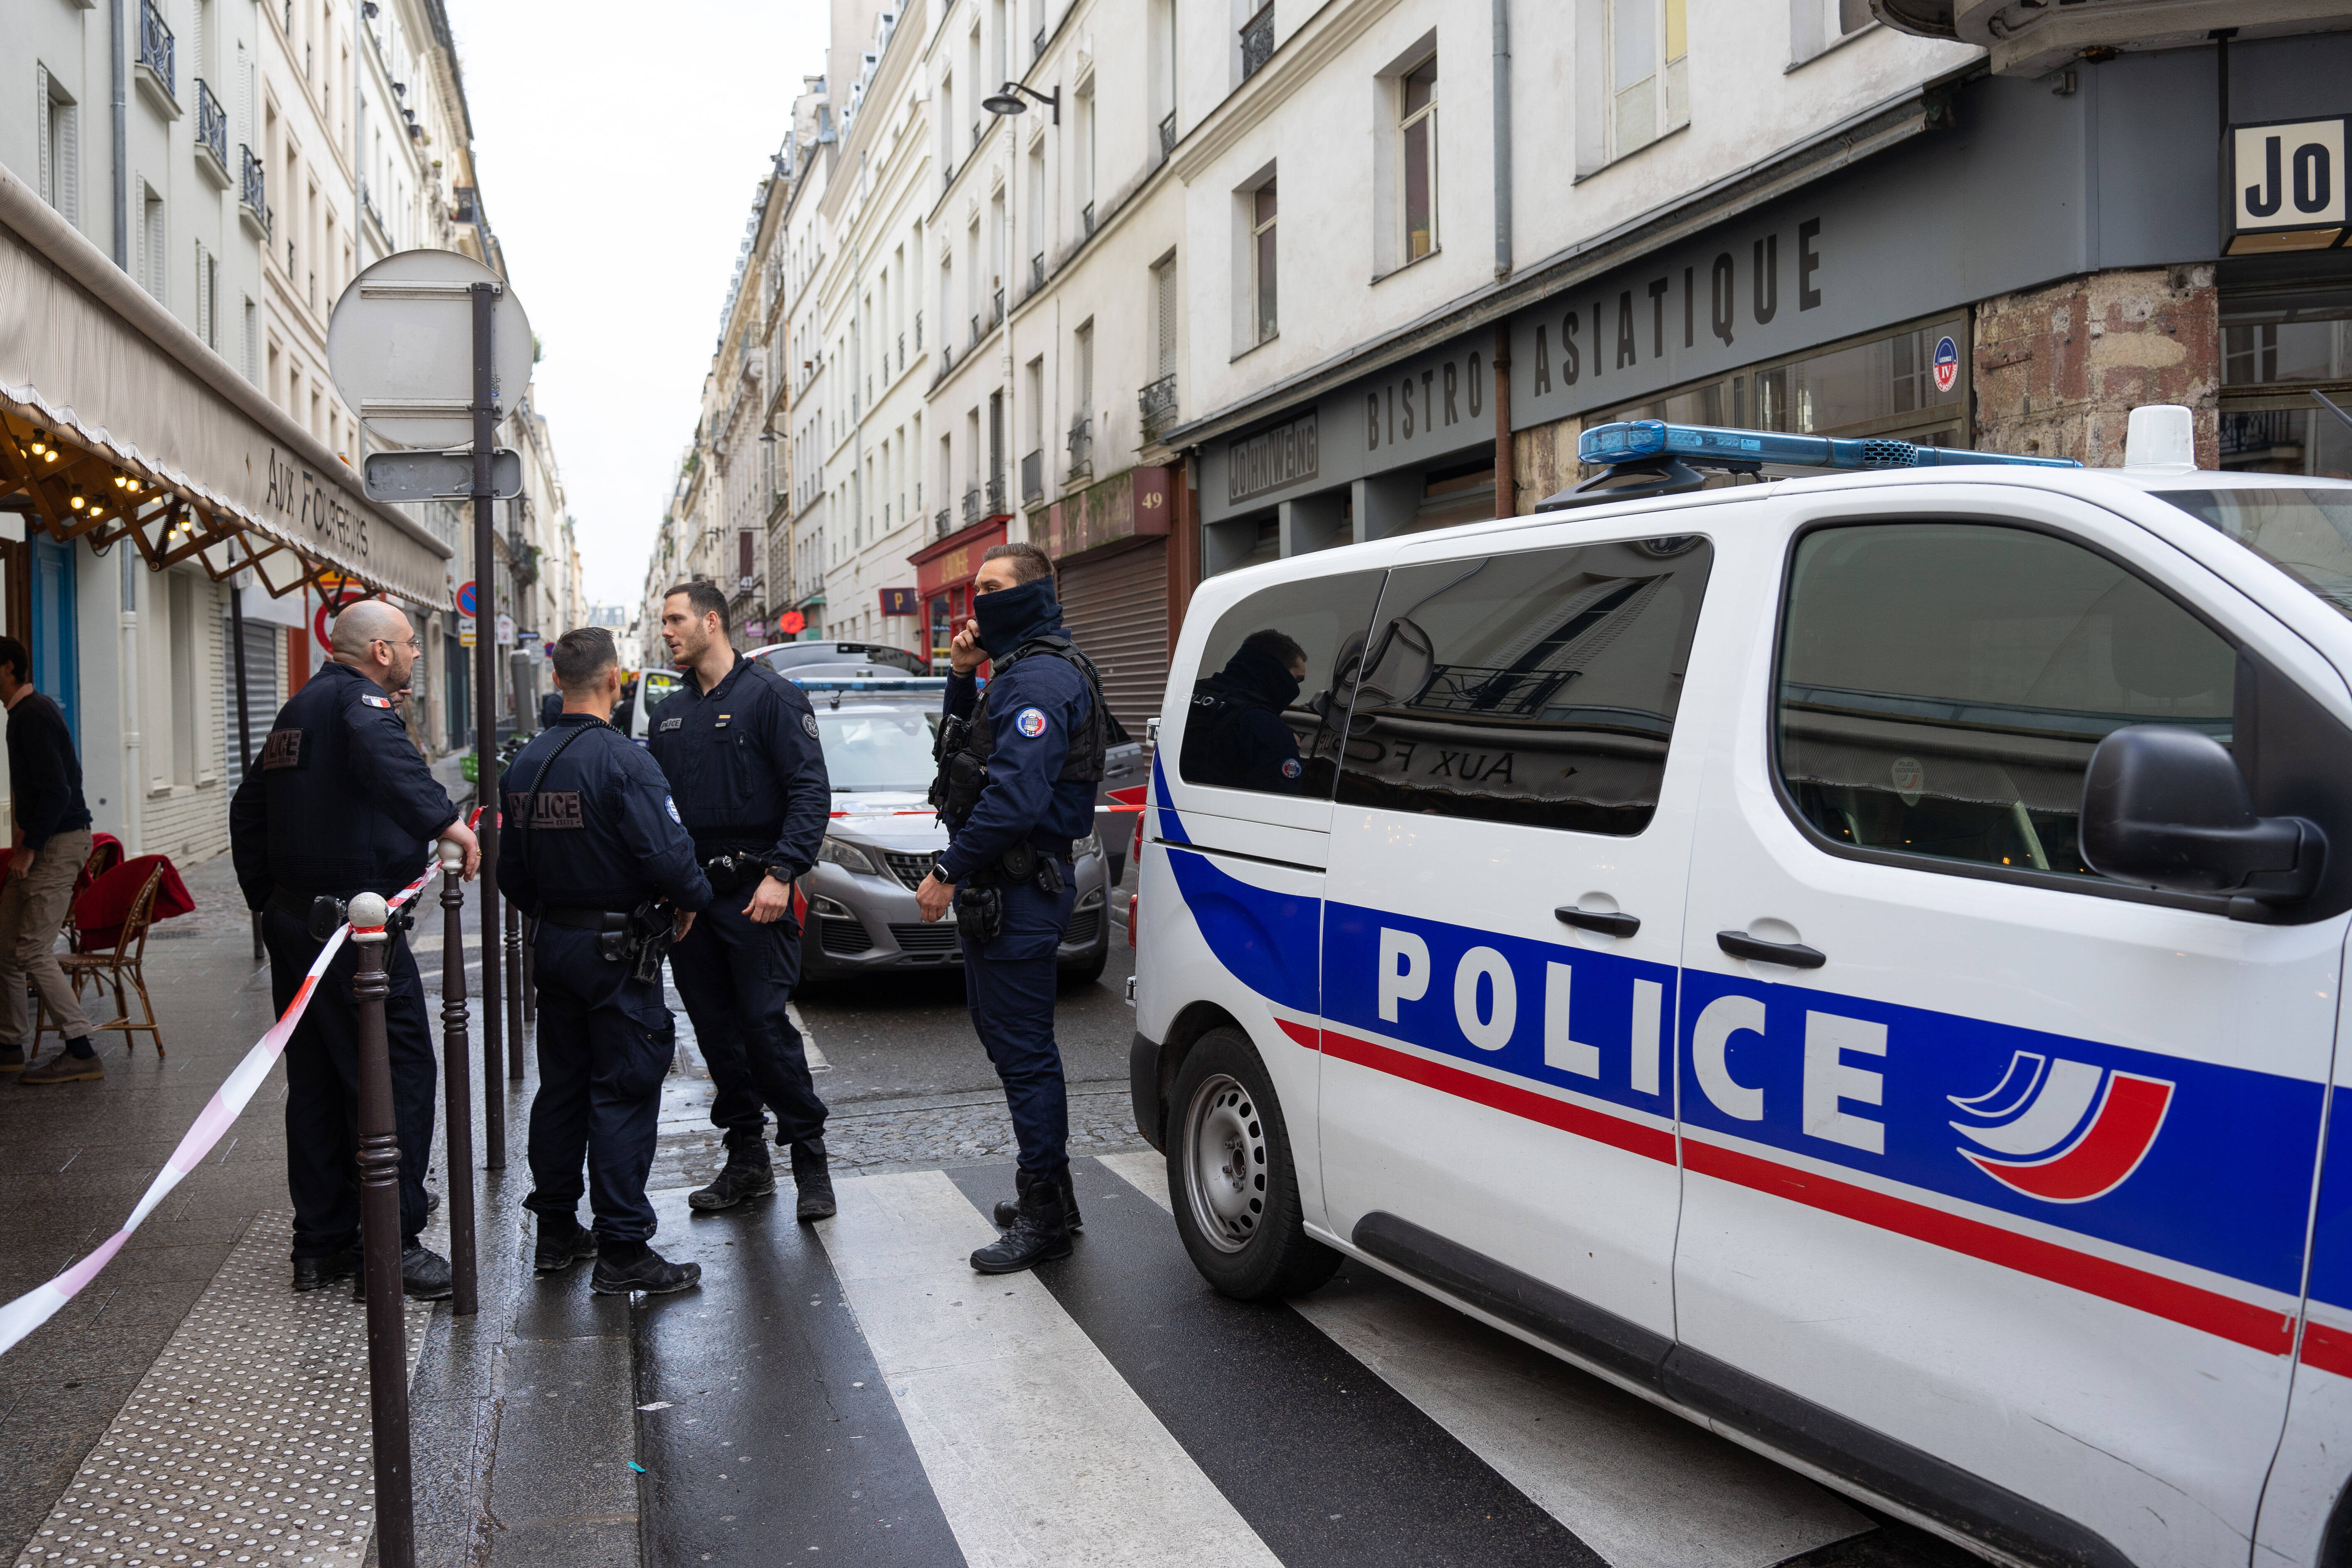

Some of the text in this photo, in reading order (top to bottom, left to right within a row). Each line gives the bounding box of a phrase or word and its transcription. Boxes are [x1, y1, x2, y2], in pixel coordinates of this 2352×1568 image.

[2245, 136, 2330, 218] JO
[1367, 216, 1821, 452] BISTRO ASIATIQUE
[1939, 355, 1952, 363] LICENCE
[1941, 365, 1952, 379] IV
[266, 447, 293, 517] AUX
[1142, 492, 1163, 509] 49
[894, 592, 903, 610] P
[661, 719, 681, 729] PLICE
[1378, 927, 1889, 1156] POLICE
